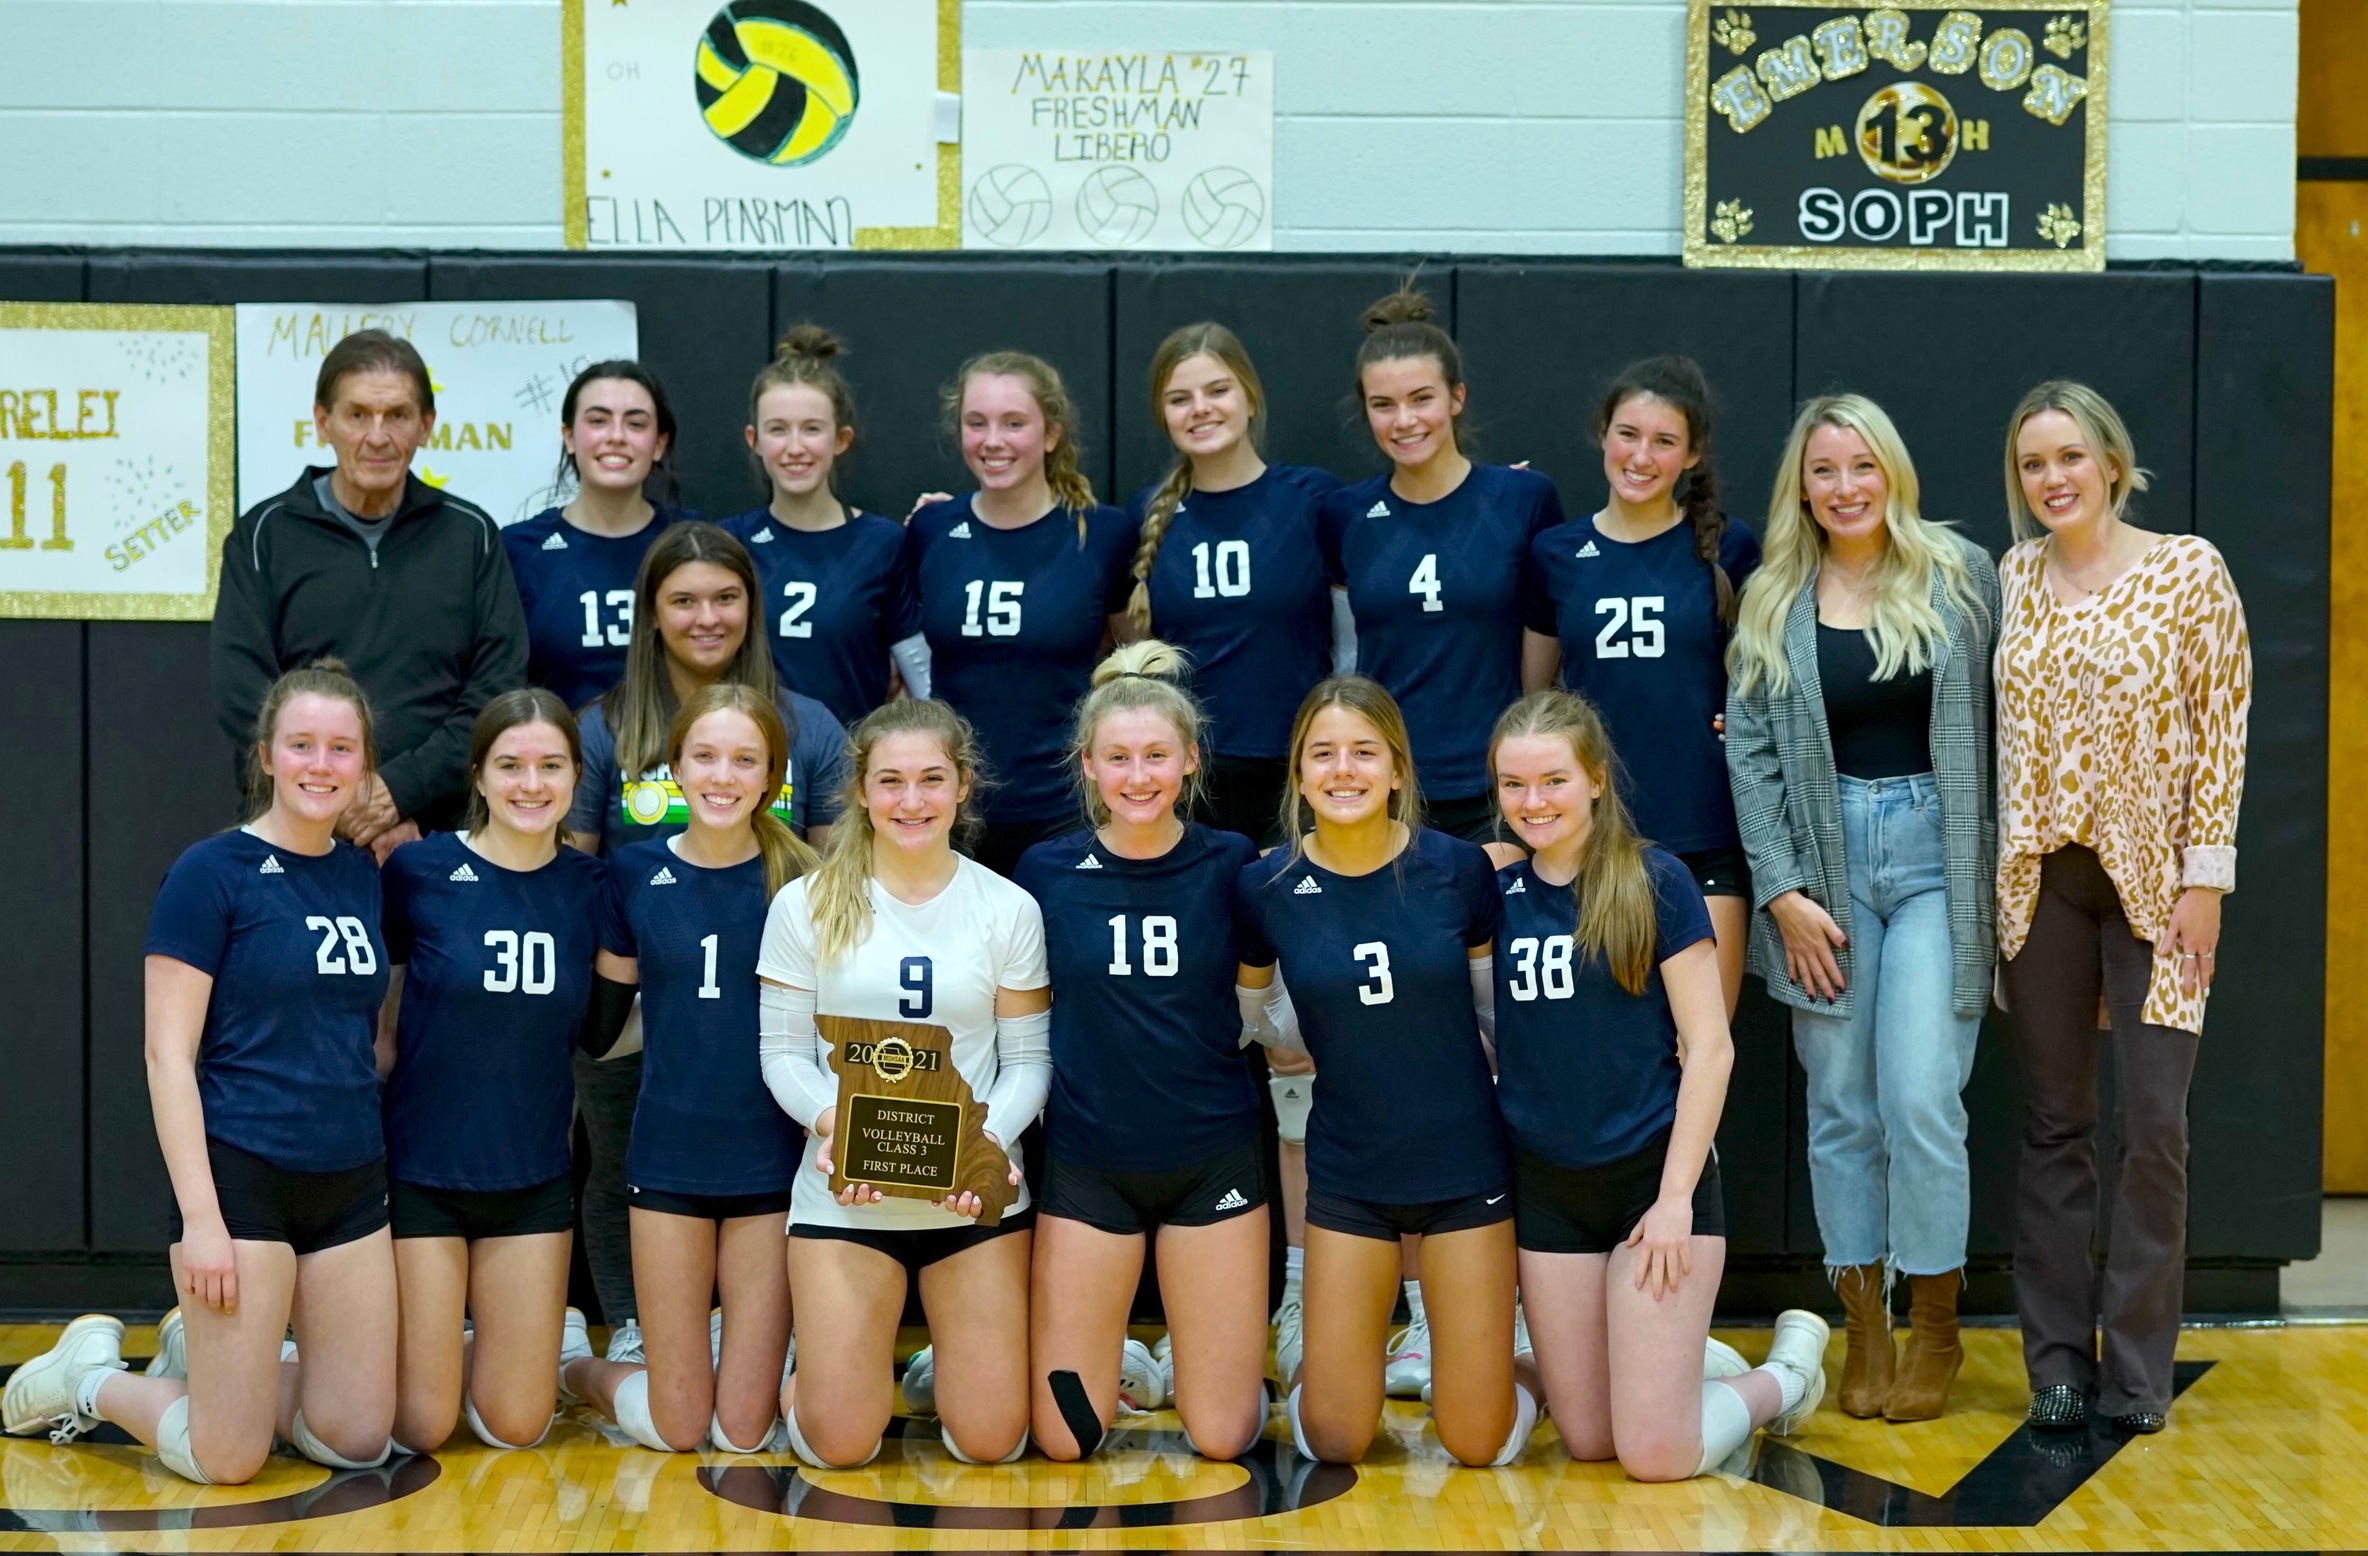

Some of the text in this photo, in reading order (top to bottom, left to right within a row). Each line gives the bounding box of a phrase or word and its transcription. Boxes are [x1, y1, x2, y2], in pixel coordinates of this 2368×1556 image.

[607, 61, 640, 81] OH
[1011, 53, 1179, 94] MAKAYLA
[1709, 9, 2088, 134] EMERSON
[1032, 96, 1206, 130] FRESHMAN
[1815, 99, 1989, 162] M 13 H
[1055, 131, 1171, 162] LIBERO
[586, 195, 853, 246] ELLA PEARMAN
[1798, 187, 2009, 247] SOPH
[449, 313, 575, 349] CORNELL
[104, 498, 201, 572] SETTER
[1191, 539, 1251, 598] 10
[1409, 554, 1444, 612] 4
[579, 589, 635, 647] 13
[779, 581, 817, 638] 2
[961, 579, 1025, 637] 15
[1595, 596, 1665, 659] 25
[449, 873, 479, 882] adidas
[650, 877, 677, 885] adidas
[1293, 886, 1322, 895] adidas
[305, 915, 377, 976] 28
[483, 930, 556, 995] 30
[698, 934, 721, 998] 1
[1108, 914, 1179, 977] 18
[1353, 941, 1394, 1006] 3
[1509, 934, 1575, 1002] 38
[899, 955, 933, 1018] 9
[848, 1044, 937, 1071] 20 21
[862, 1128, 945, 1146] VOLLEYBALL
[877, 1109, 936, 1125] DISTRICT
[863, 1160, 938, 1177] FIRST PLACE
[877, 1141, 928, 1157] CLASS 3
[1215, 1198, 1249, 1211] adidas
